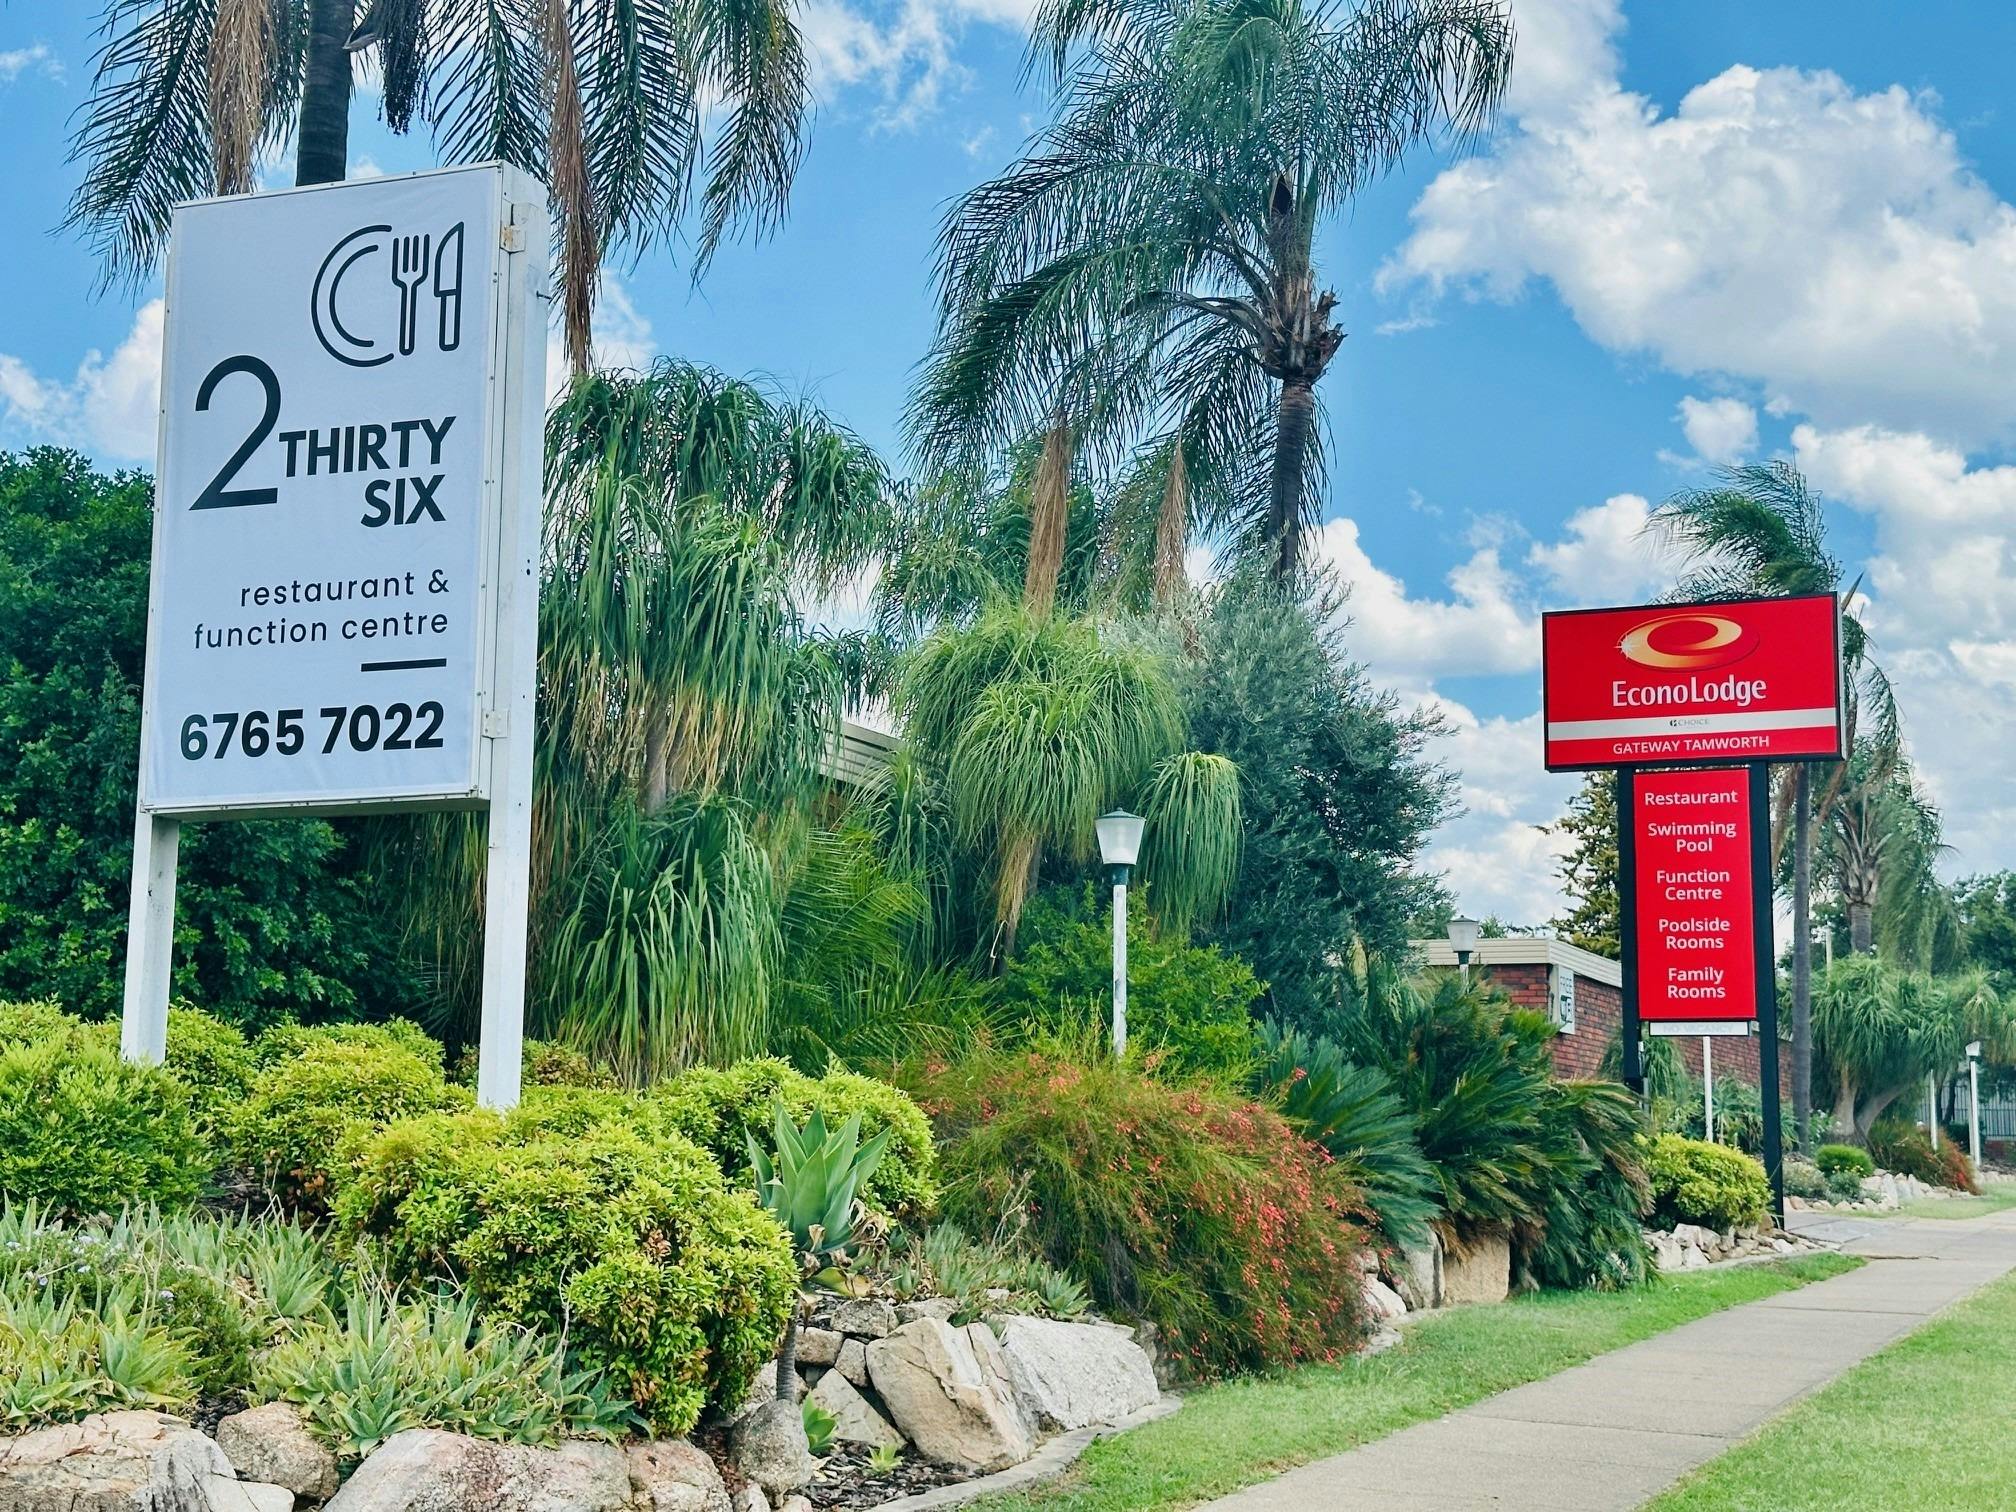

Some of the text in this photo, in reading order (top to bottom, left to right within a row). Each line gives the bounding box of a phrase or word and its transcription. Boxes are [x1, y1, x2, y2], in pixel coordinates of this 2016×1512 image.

[189, 355, 456, 510] 2 THIRTY
[359, 473, 446, 527] SIX
[242, 569, 449, 606] restaurant &
[195, 612, 447, 648] function centre
[181, 701, 443, 760] 6765 7022
[1613, 735, 1770, 755] GATEWAY TAMWORTH
[1645, 790, 1738, 805] Restaurant
[1648, 821, 1736, 838] Swimming
[1677, 838, 1712, 852] Pool
[1657, 869, 1730, 883] Function
[1666, 887, 1722, 900] Centre
[1659, 917, 1730, 932] Poolside
[1665, 936, 1724, 949] Rooms
[1669, 967, 1723, 984] Family
[1668, 985, 1725, 998] Rooms
